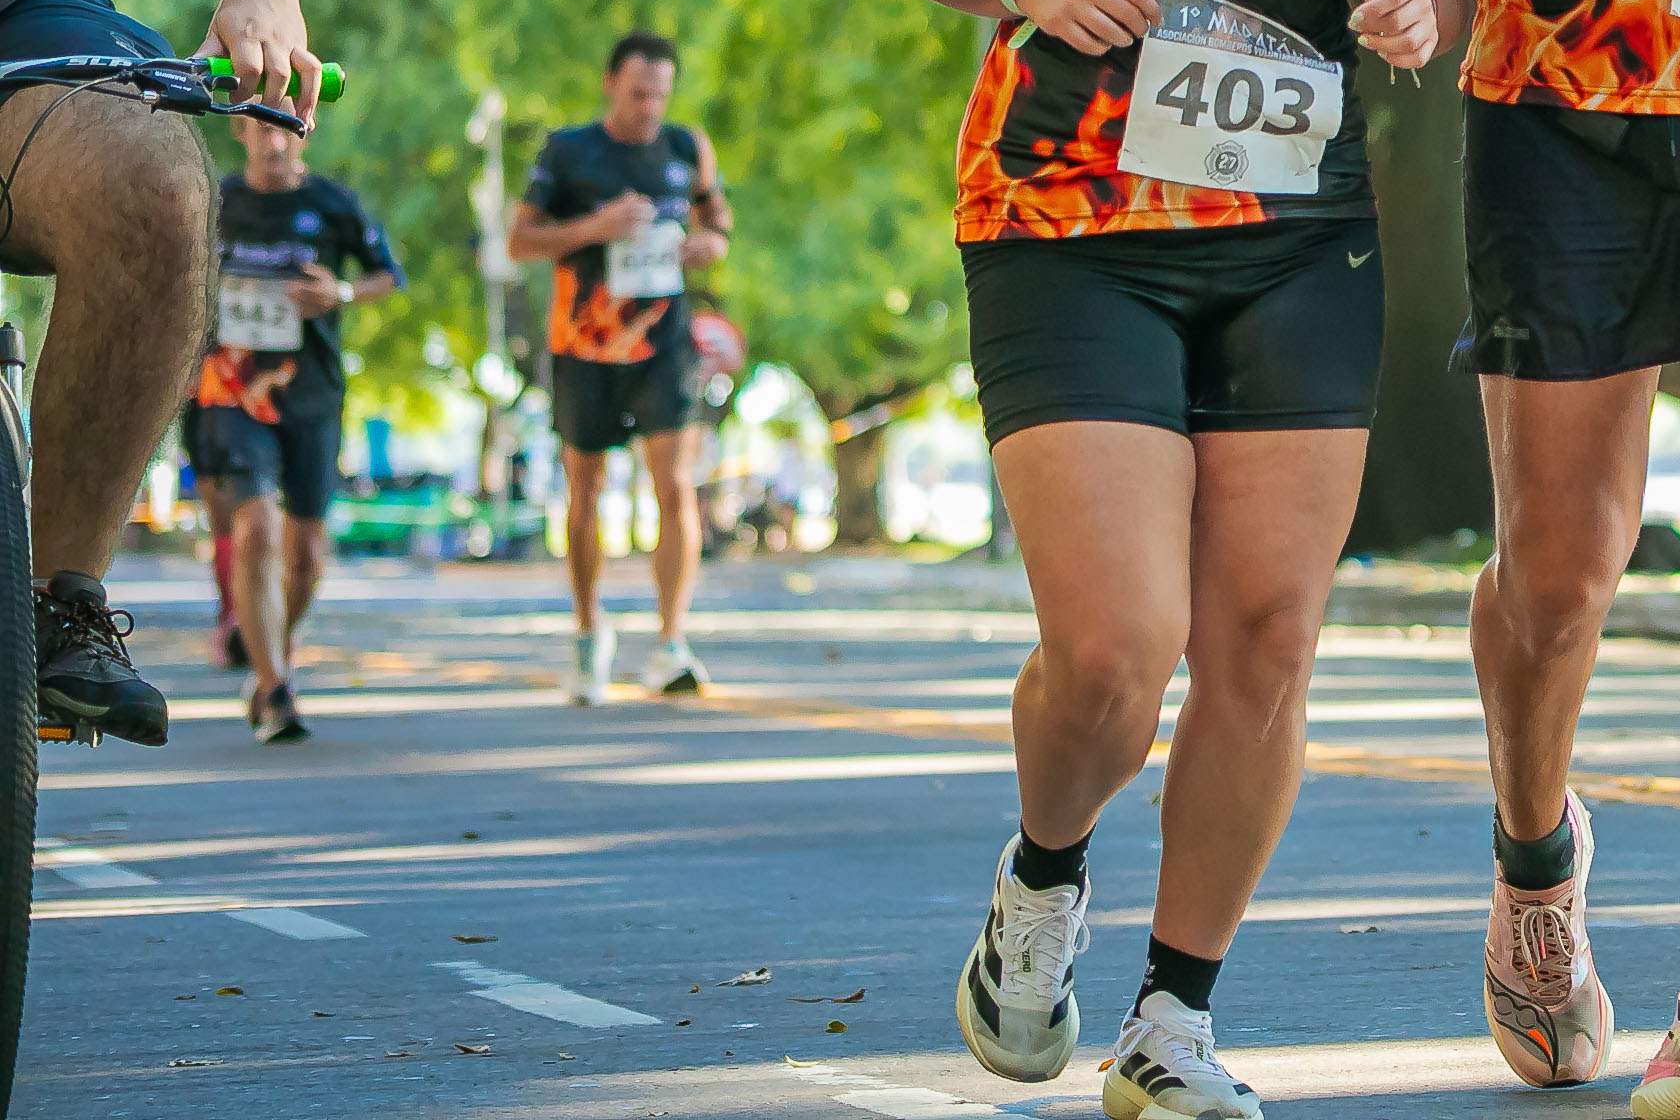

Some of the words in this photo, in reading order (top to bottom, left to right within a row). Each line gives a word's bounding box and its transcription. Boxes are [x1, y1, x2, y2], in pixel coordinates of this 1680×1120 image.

[1156, 28, 1207, 46] ASOCIACIÓN
[1155, 61, 1316, 136] 403
[1218, 153, 1238, 170] 27
